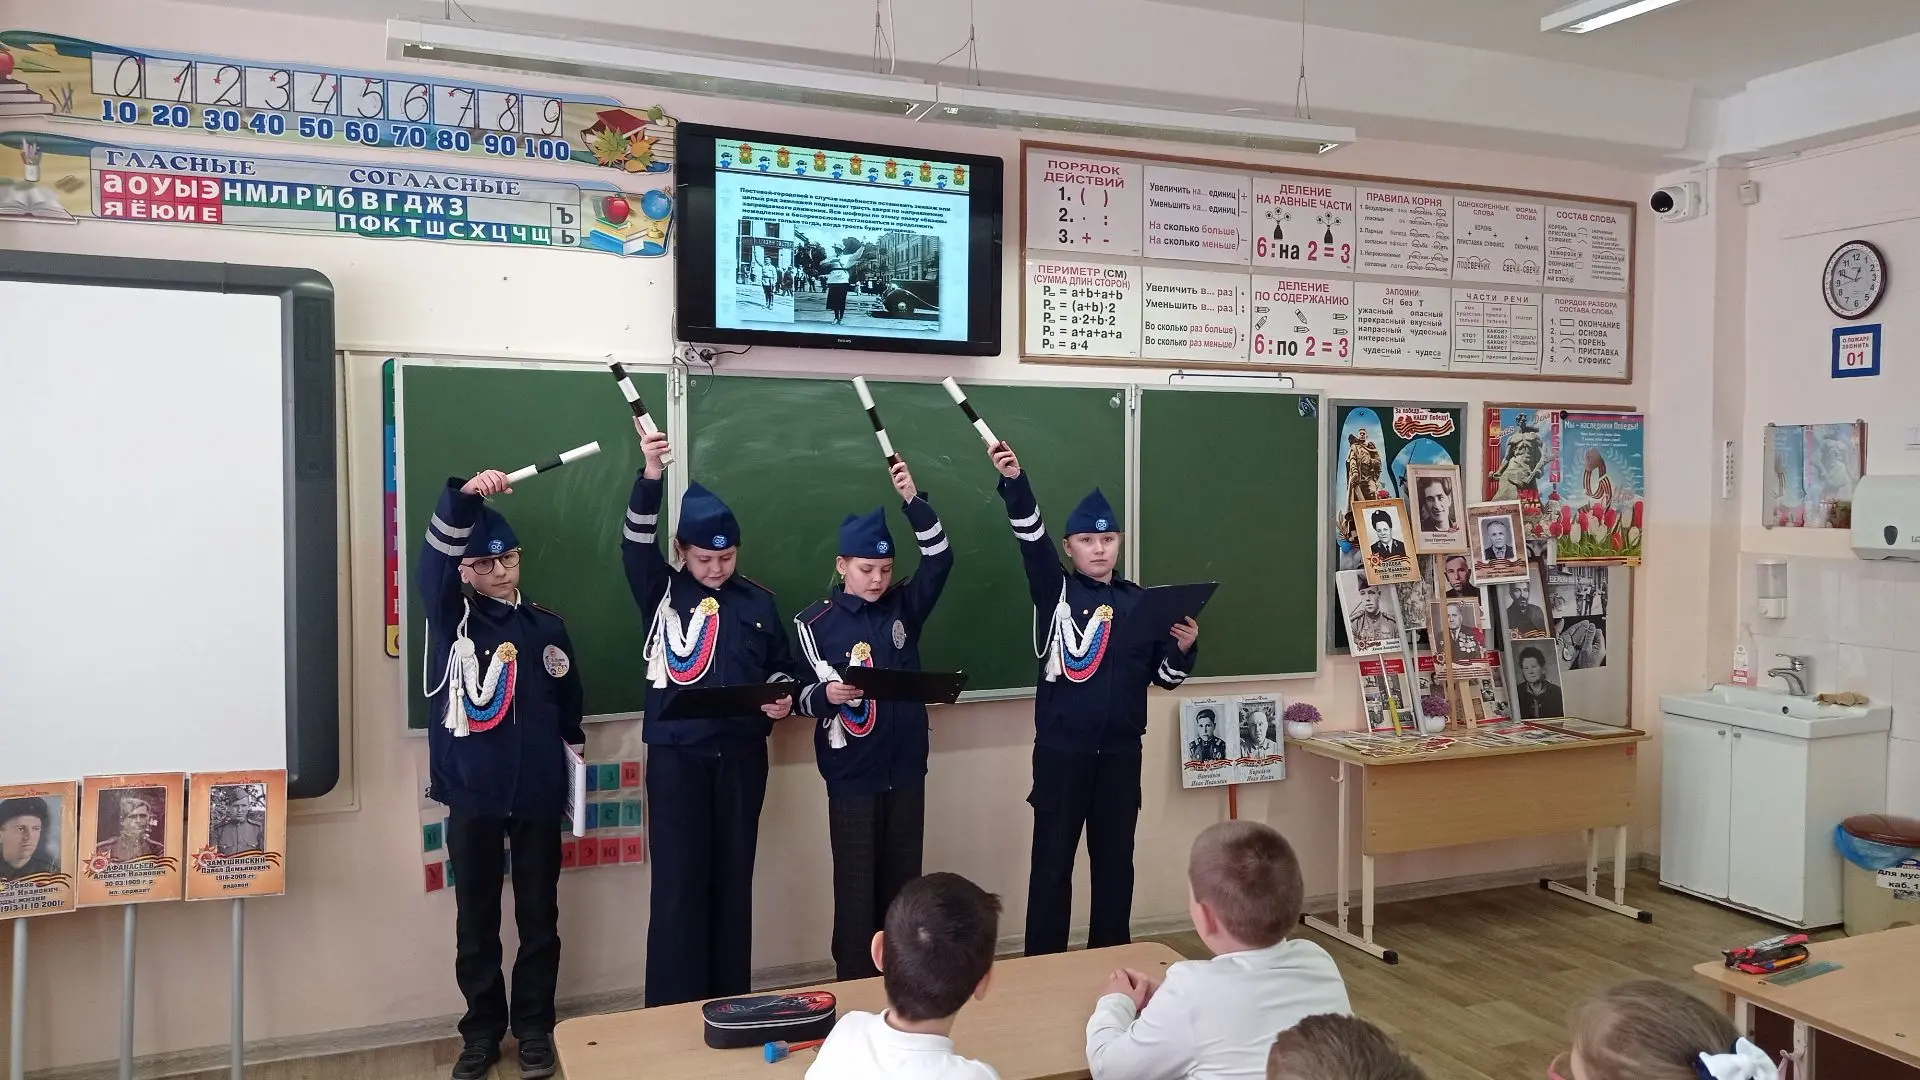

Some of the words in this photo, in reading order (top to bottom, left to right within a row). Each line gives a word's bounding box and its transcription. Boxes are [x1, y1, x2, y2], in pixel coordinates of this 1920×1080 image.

[213, 65, 241, 106] 2
[265, 70, 290, 110] 3
[311, 72, 339, 114] 4
[357, 78, 383, 118] 5
[404, 84, 428, 123] 6
[449, 89, 474, 127] 7
[498, 93, 519, 132] 8
[541, 99, 562, 135] 9
[102, 100, 140, 124] 10
[152, 104, 189, 128] 20
[203, 108, 241, 132] 30
[249, 112, 285, 136] 40
[299, 116, 335, 140] 50
[345, 121, 379, 143] 60
[391, 125, 426, 148] 70
[436, 130, 471, 152] 80
[484, 134, 516, 156] 90
[525, 139, 571, 161] 100
[106, 150, 256, 176] ГЛАСНЫЕ
[349, 168, 521, 196] СОГЛАСНЫЕ
[1048, 160, 1120, 175] ПОРЯДОК
[1044, 172, 1124, 188] ДЕЙСТВИЙ
[1058, 187, 1071, 202] 1.
[1150, 183, 1190, 194] Увеличить
[1209, 190, 1236, 200] единиц
[1280, 185, 1331, 197] ДЕЛЕНИЕ
[1150, 199, 1190, 210] Уменьшить
[1209, 206, 1236, 215] единиц
[1257, 194, 1271, 204] НА
[1274, 196, 1317, 208] РАВНЫЕ
[1320, 200, 1352, 211] ЧАСТИ
[1366, 193, 1409, 204] ПРАВИЛА
[1412, 197, 1442, 207] КОРНЯ
[1458, 201, 1510, 211] ОДНОКОРЕННЫЕ
[1058, 208, 1074, 222] 2.
[1557, 211, 1588, 220] СОСТАВ
[1590, 215, 1616, 224] СЛОВА
[1150, 221, 1161, 230] На
[1163, 223, 1199, 233] сколько
[1202, 224, 1235, 236] больше
[1058, 229, 1074, 244] 3.
[1150, 236, 1161, 244] На
[1163, 238, 1199, 247] сколько
[1202, 240, 1236, 250] меньше
[1257, 237, 1267, 257] 6
[1279, 243, 1299, 260] на
[1308, 241, 1317, 261] 2
[1341, 244, 1350, 263] 3
[1852, 253, 1860, 261] 12
[1038, 265, 1101, 276] ПЕРИМЕТР
[1103, 269, 1127, 280] (СМ)
[1034, 275, 1067, 285] (СУММА
[1069, 276, 1092, 286] ДЛИН
[1094, 279, 1131, 289] СТОРОН)
[1278, 281, 1329, 293] ДЕЛЕНИЕ
[1145, 283, 1198, 295] Увеличить
[1217, 289, 1233, 298] раз
[1386, 288, 1421, 297] ЗАПОМНИ:
[1467, 293, 1497, 301] ЧАСТИ
[1255, 292, 1270, 301] ПО
[1273, 294, 1349, 306] СОДЕРЖАНИЮ
[1400, 298, 1413, 306] без
[1145, 299, 1198, 310] Уменьшить
[1217, 305, 1233, 314] раз
[1358, 307, 1393, 315] ужасный
[1410, 310, 1443, 318] опасный
[1145, 322, 1155, 330] Во
[1157, 323, 1188, 332] сколько
[1189, 325, 1203, 334] раз
[1205, 325, 1233, 334] больше
[1358, 317, 1405, 325] прекрасный
[1410, 319, 1442, 327] вкусный
[1578, 320, 1620, 329] ОКОНЧАНИЕ
[1358, 326, 1402, 334] напрасный
[1410, 329, 1447, 337] чудесный
[1157, 338, 1187, 346] сколько
[1189, 339, 1202, 348] раз
[1204, 340, 1233, 349] меньше
[1255, 334, 1265, 354] 6
[1277, 342, 1298, 356] по
[1306, 336, 1315, 356] 2
[1339, 338, 1348, 357] 3
[1363, 347, 1401, 355] чудесный
[1416, 349, 1441, 357] чудеса
[1579, 348, 1619, 356] ПРИСТАВКА
[1847, 352, 1864, 366] 01
[1578, 356, 1611, 365] СУФФИКС
